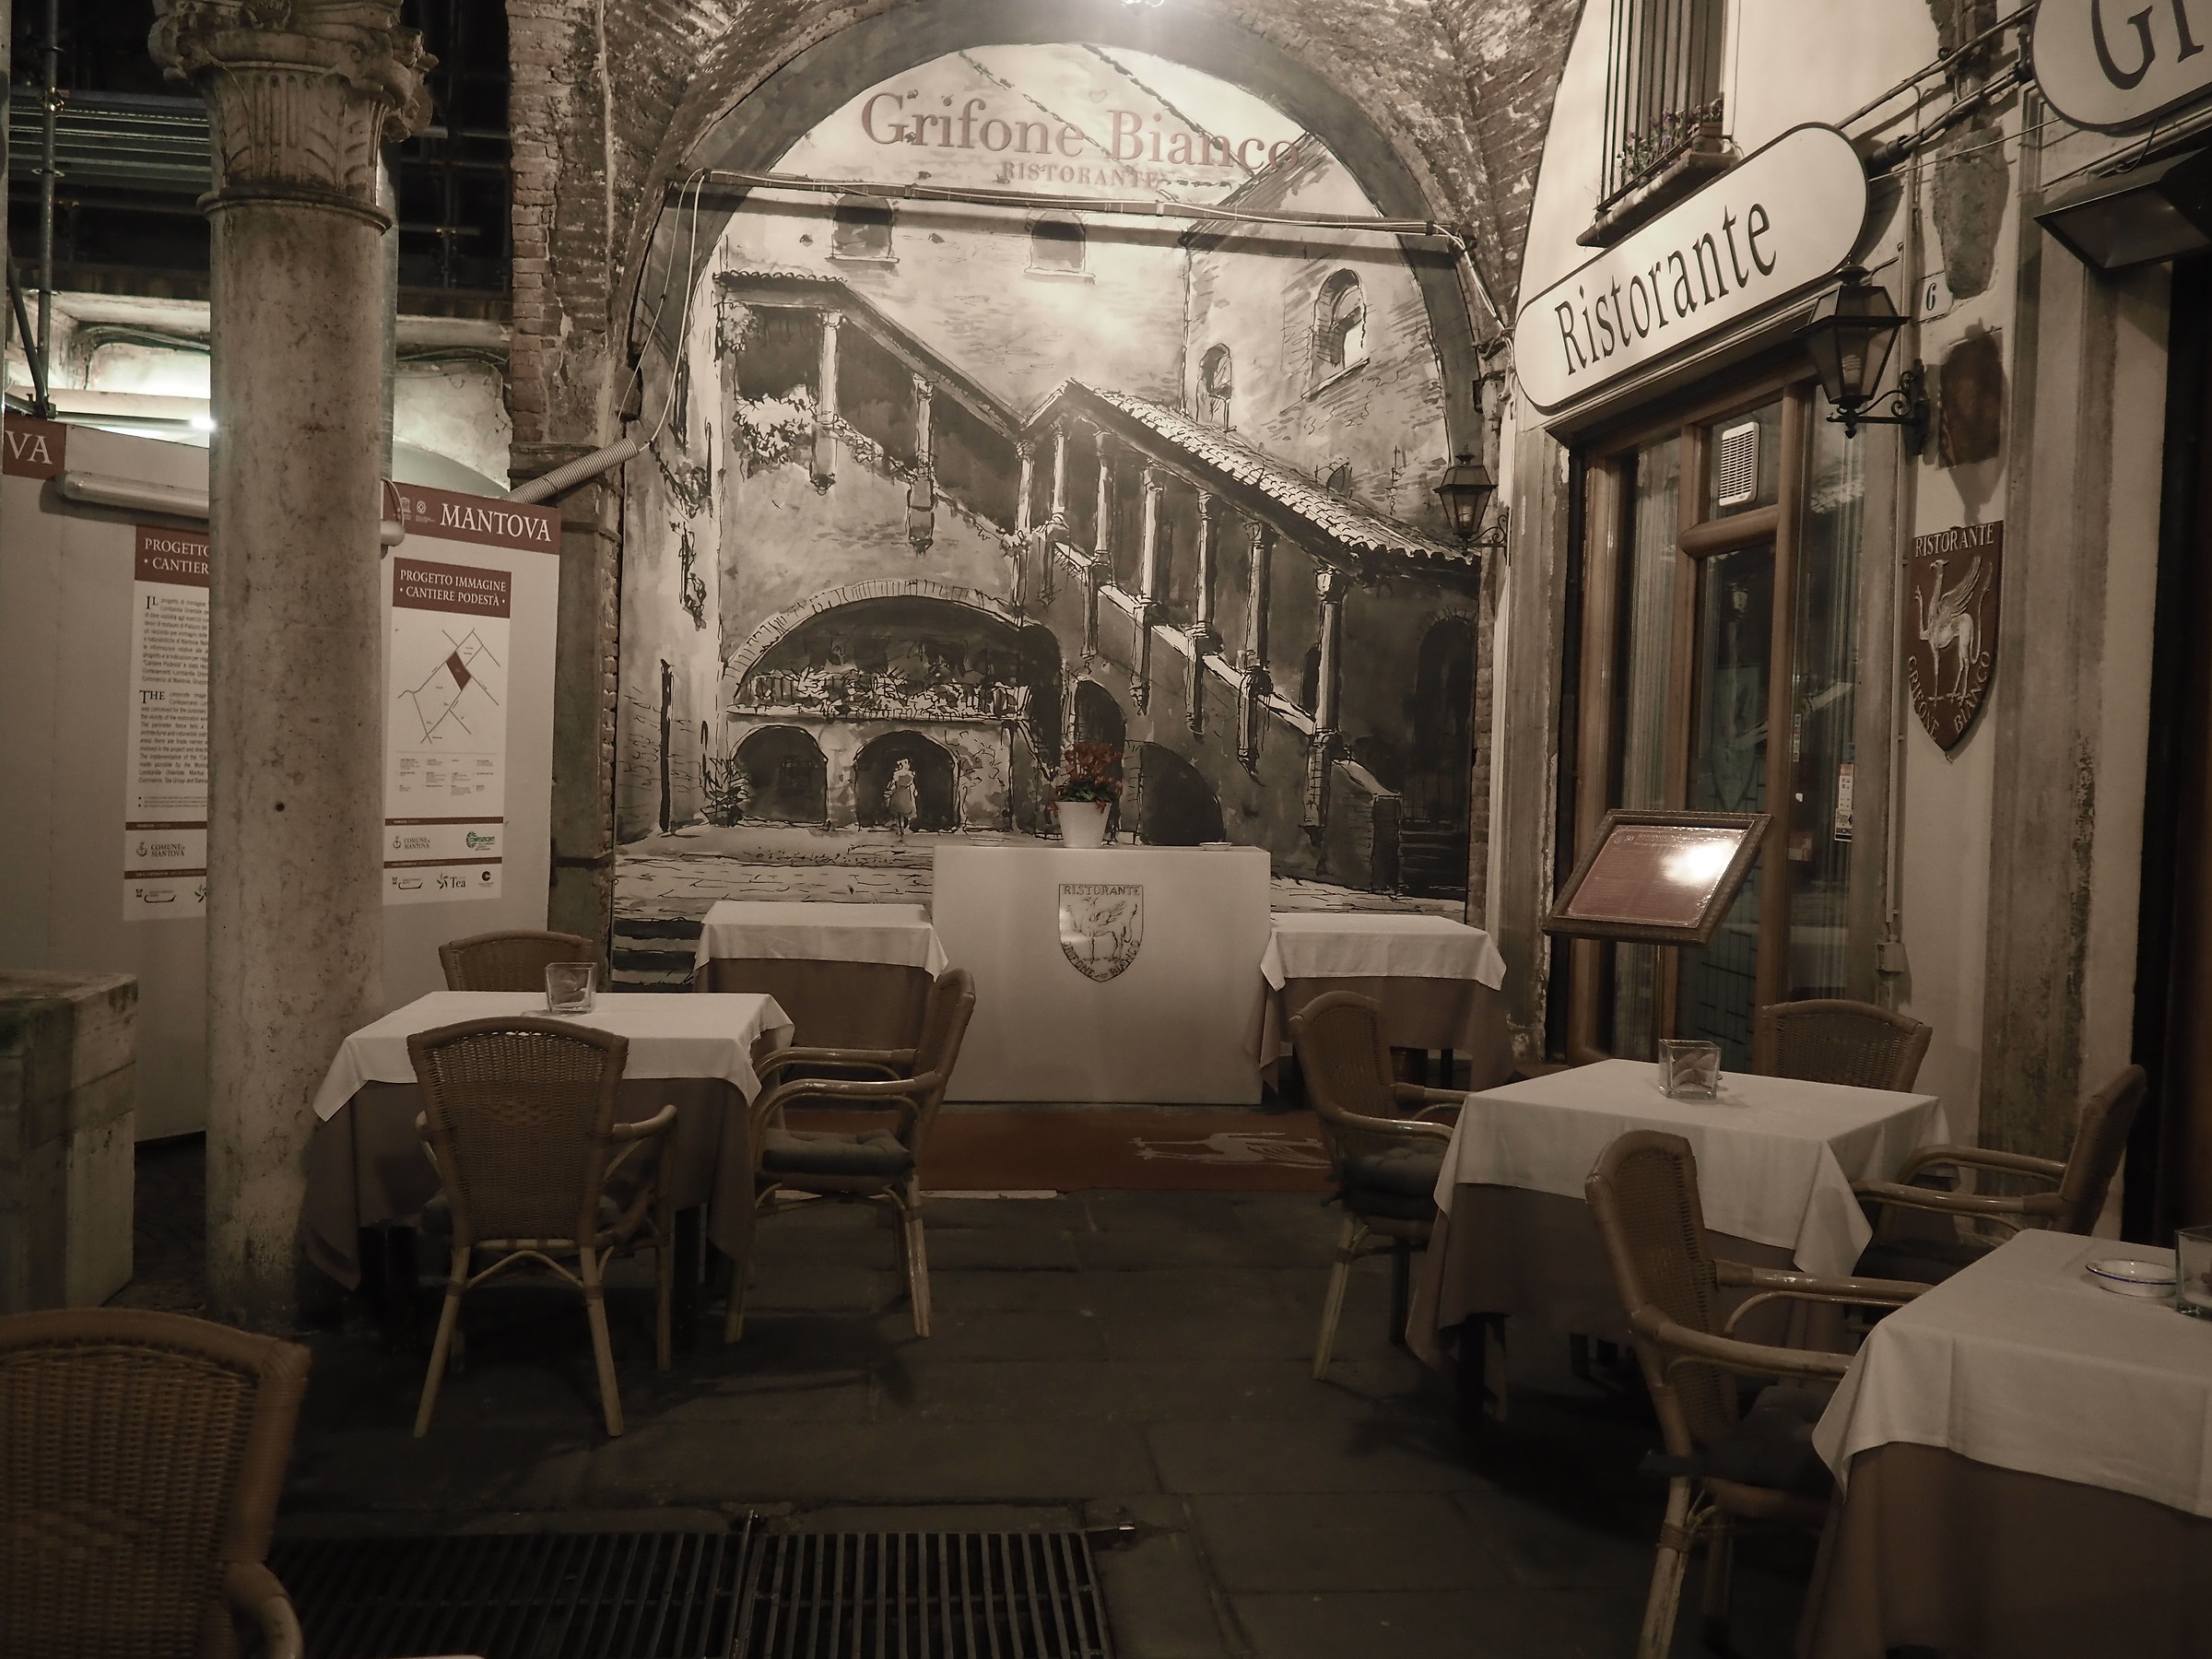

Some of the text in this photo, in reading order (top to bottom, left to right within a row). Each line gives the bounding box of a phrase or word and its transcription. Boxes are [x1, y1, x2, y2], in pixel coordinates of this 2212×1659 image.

[861, 92, 1300, 173] Grifone Bianco
[1002, 161, 1159, 188] RISTORANTE
[1554, 203, 1777, 376] Ristorante
[1926, 282, 1936, 312] 6
[6, 430, 53, 465] VA
[440, 503, 552, 542] MANTOVA
[1915, 523, 1994, 557] RISTORANTE
[400, 570, 506, 592] PROGETTO IMMAGINE
[406, 586, 500, 606] CANTIERE PODESTÀ
[1954, 651, 1991, 735] BIANCO
[451, 877, 466, 888] Tea
[1063, 885, 1141, 896] RISTORANTE
